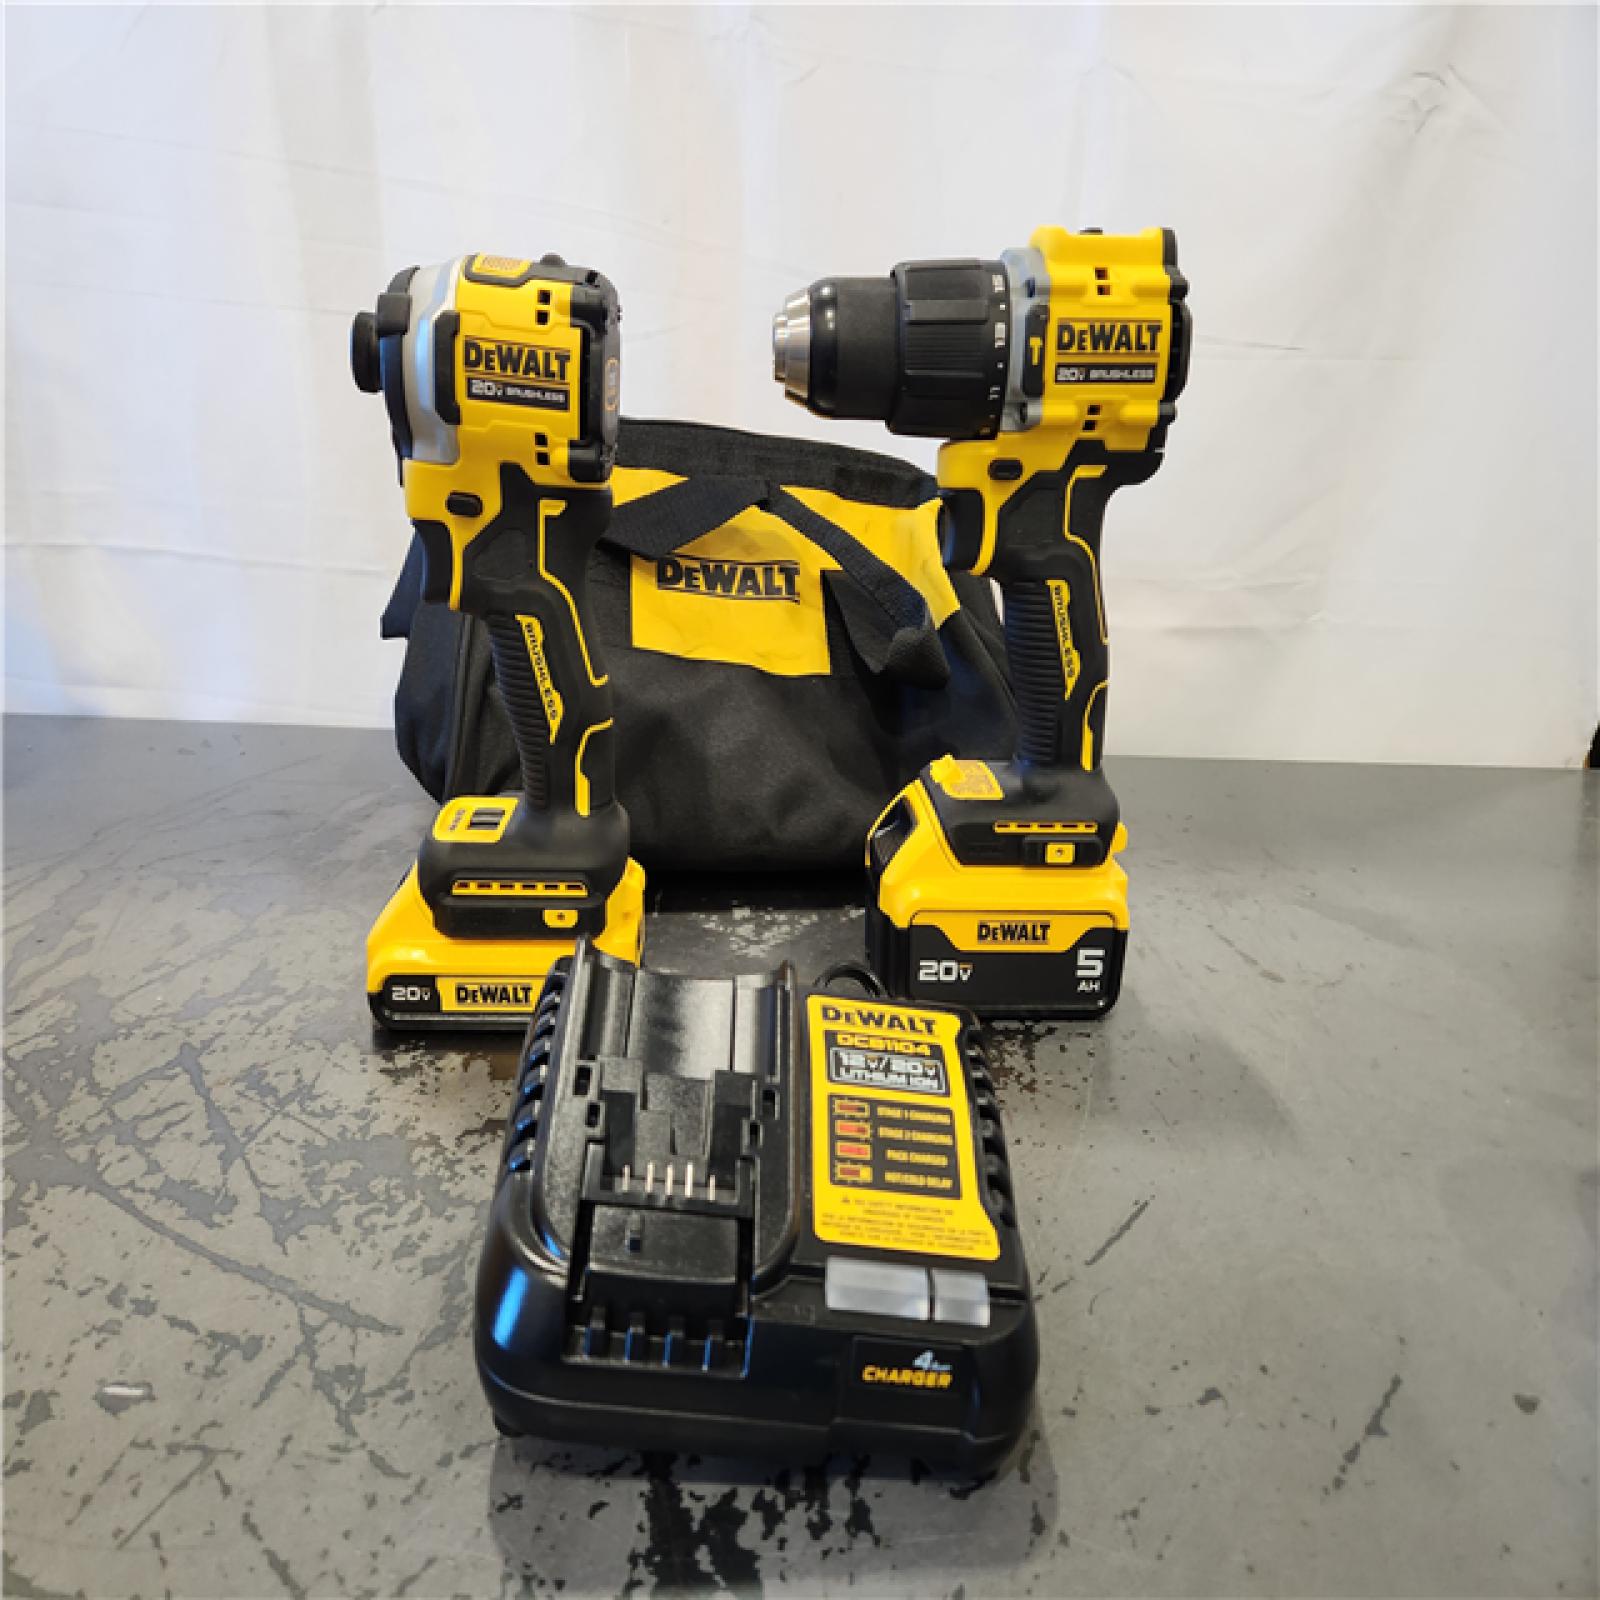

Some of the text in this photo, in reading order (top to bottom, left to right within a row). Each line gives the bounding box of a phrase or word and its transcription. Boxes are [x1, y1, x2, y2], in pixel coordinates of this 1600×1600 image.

[1057, 323, 1162, 351] DEWALT
[464, 341, 570, 380] DEWALT
[657, 558, 800, 597] DEWALT
[525, 622, 557, 721] BRUSHLESS
[977, 923, 1050, 941] DEWALT
[1075, 948, 1105, 978] 5
[455, 986, 532, 1004] DEWALT
[1077, 980, 1100, 993] AH
[822, 1005, 936, 1035] DEWALT
[863, 1365, 952, 1389] CHARGER
